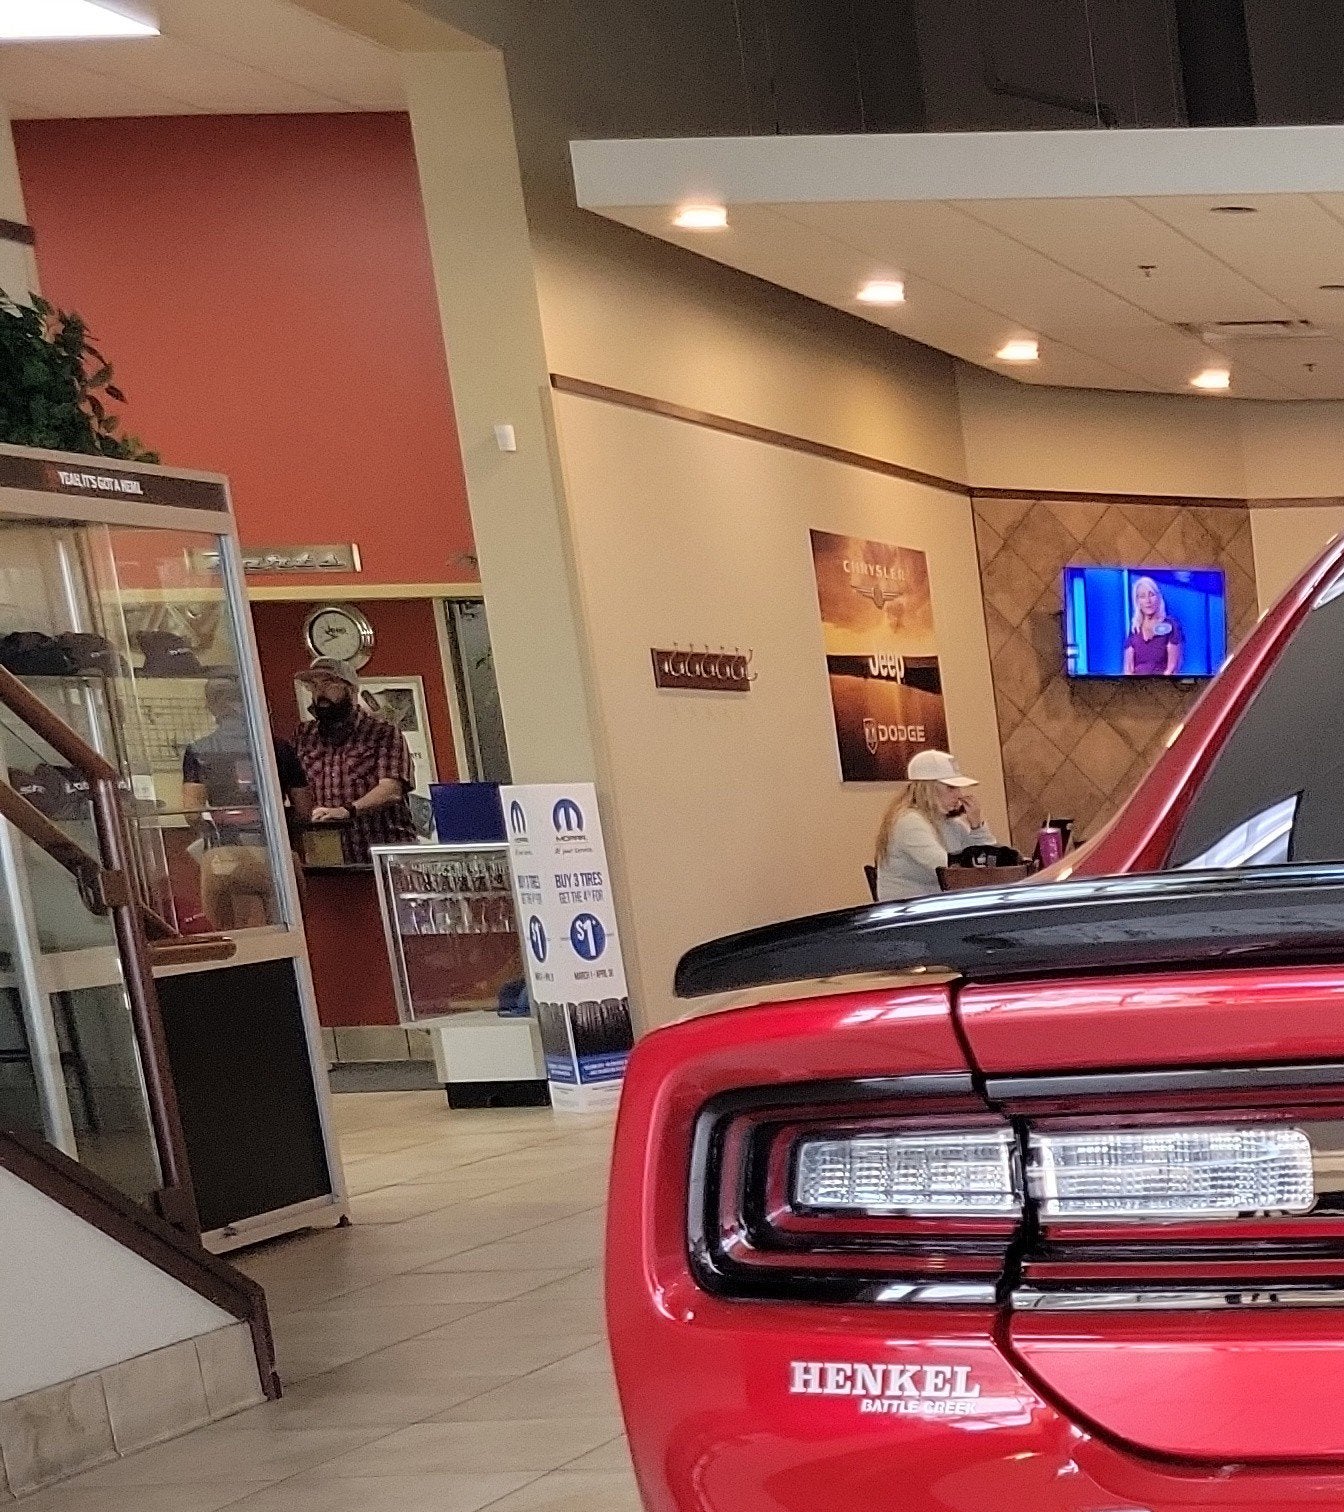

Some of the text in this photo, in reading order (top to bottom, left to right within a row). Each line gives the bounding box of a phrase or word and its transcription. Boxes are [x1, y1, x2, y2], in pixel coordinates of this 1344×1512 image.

[843, 560, 906, 582] CHRYSLER
[868, 650, 906, 684] Jeep
[878, 724, 926, 743] DODGE
[555, 874, 572, 889] BUY
[574, 873, 579, 887] 3
[580, 871, 603, 887] TIRES
[790, 1361, 981, 1398] HENKEL
[861, 1399, 977, 1414] BATTLE CREEK
